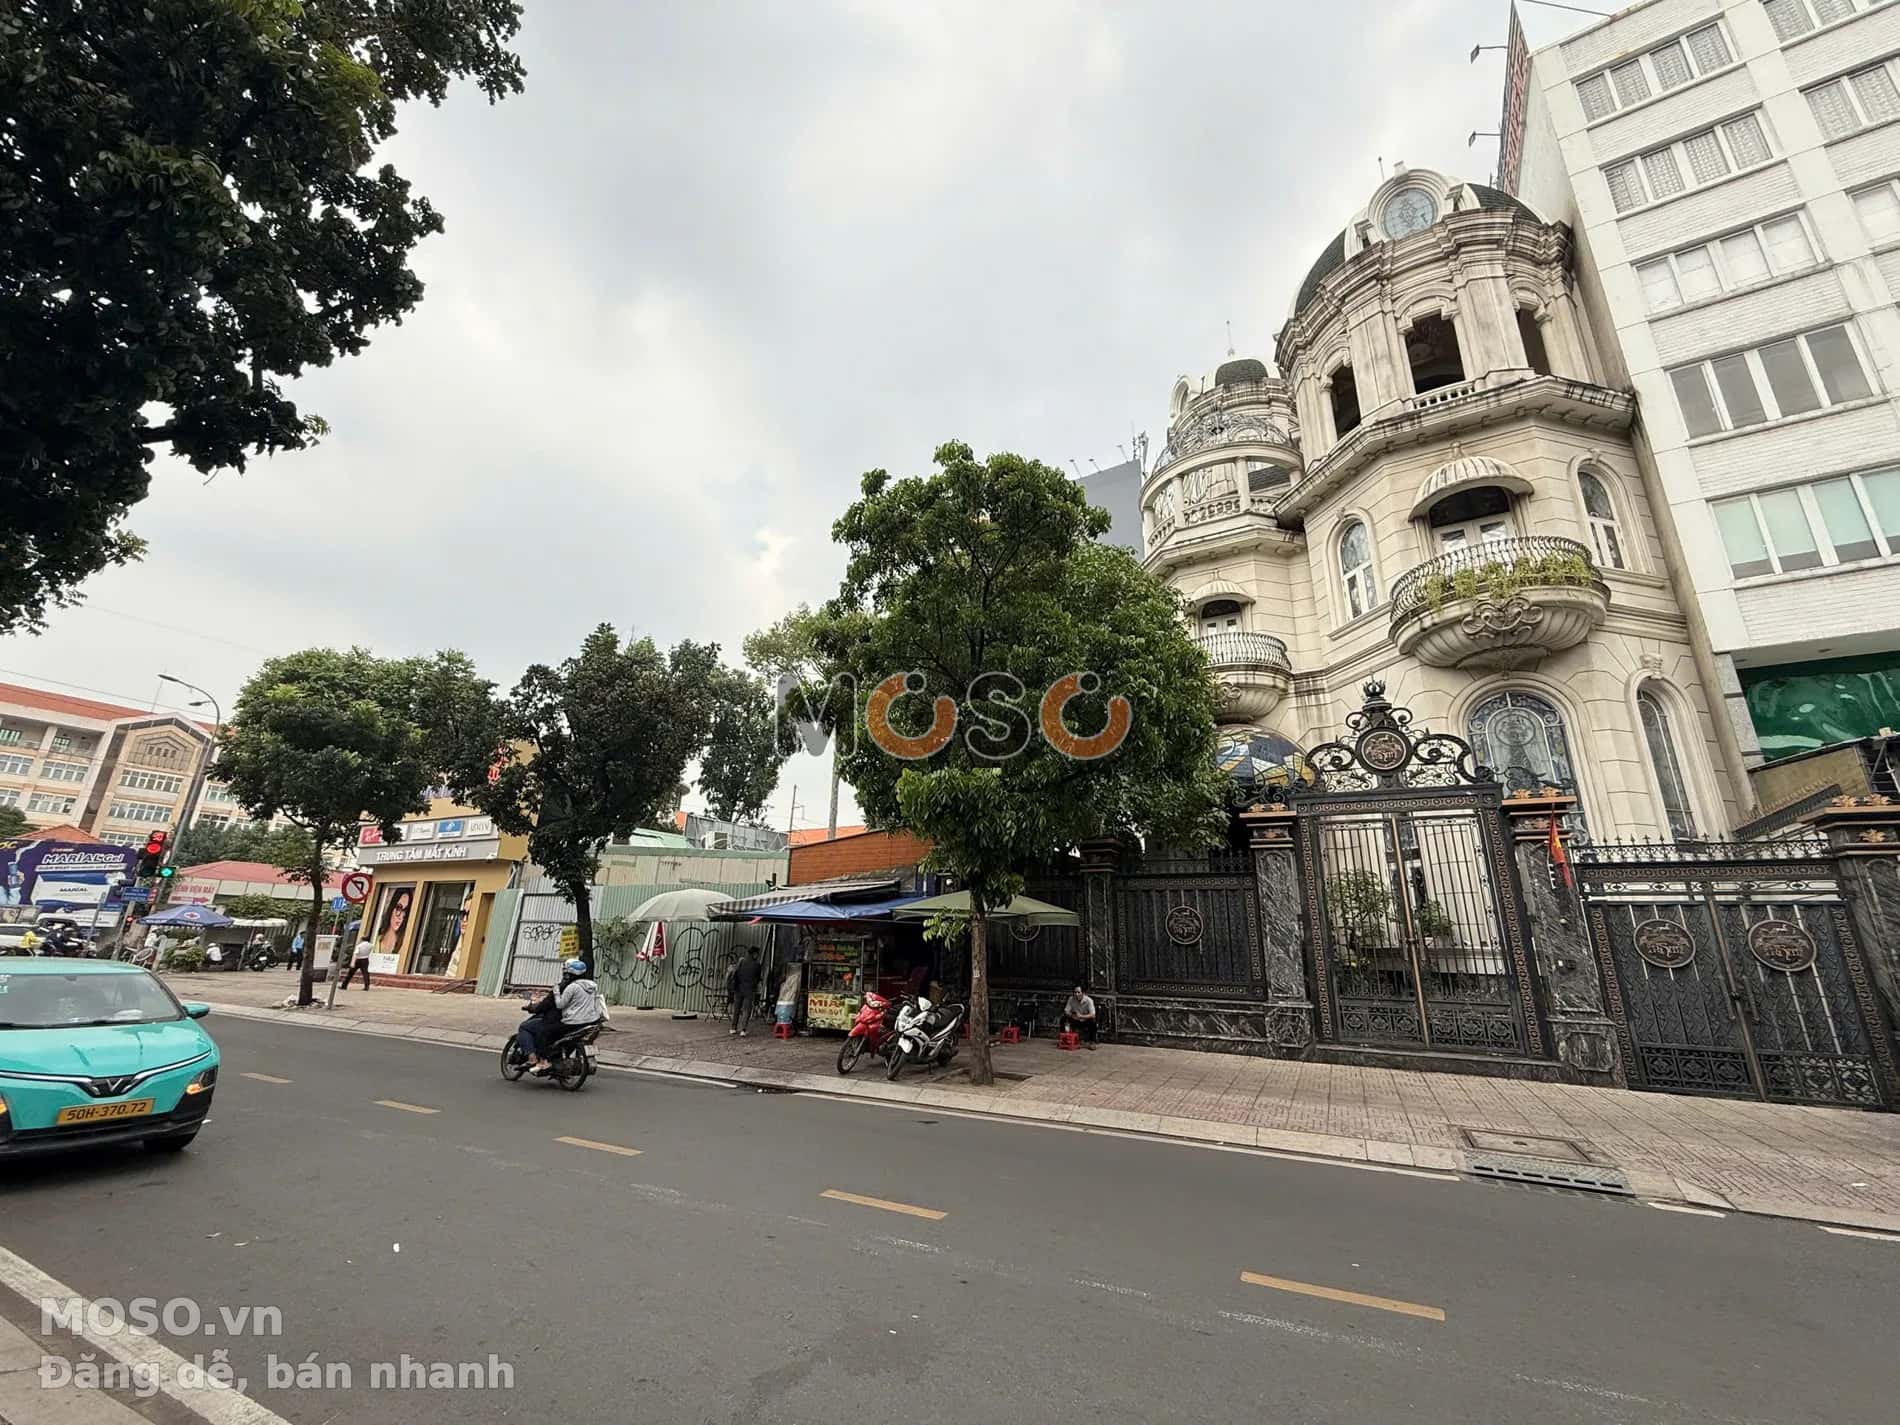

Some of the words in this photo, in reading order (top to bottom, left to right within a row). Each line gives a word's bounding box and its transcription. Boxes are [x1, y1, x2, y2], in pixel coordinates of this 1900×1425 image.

[376, 850, 403, 861] TRUNG
[404, 846, 423, 860] TÂM
[424, 843, 444, 859] MẮT
[445, 844, 466, 858] KÍNH
[66, 1101, 147, 1121] 50H-370.72
